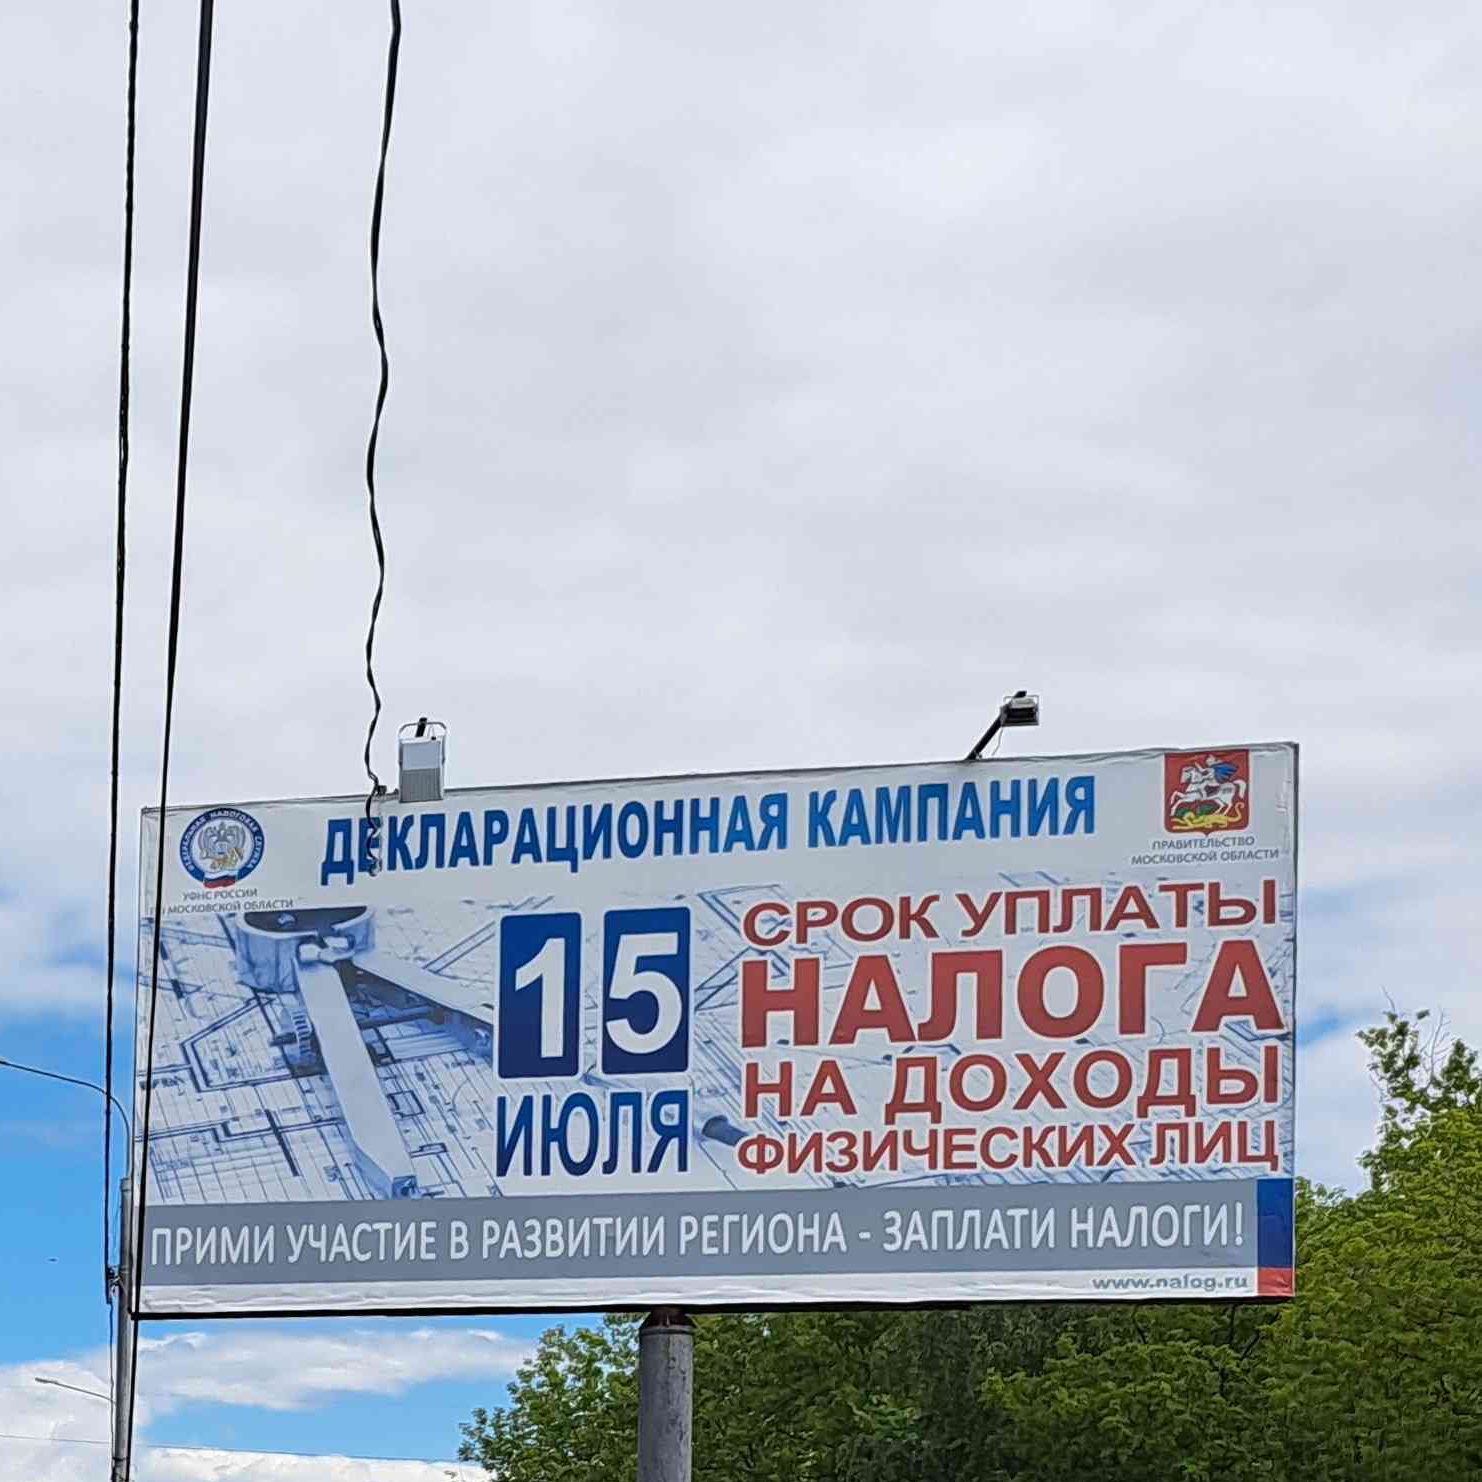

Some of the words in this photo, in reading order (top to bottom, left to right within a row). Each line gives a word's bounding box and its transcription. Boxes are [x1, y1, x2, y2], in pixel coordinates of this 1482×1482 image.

[321, 792, 789, 885] ДЕКЛАРАЦИОННАЯ
[808, 776, 1095, 848] КАМПАНИЯ
[1131, 850, 1217, 865] МОСКОВСКОЙ
[1221, 849, 1279, 860] ОБЛАСТИ
[1152, 836, 1255, 850] ПРАВИТЕЛЬСТВО
[168, 901, 241, 914] МОСКОВСКОЙ
[244, 900, 293, 910] ОБЛАСТИ
[182, 890, 212, 901] УФНС
[214, 888, 258, 899] РОССИИ
[744, 894, 939, 947] СРОК
[955, 880, 1276, 938] УПЛАТЫ
[515, 931, 683, 1058] 15
[741, 939, 1285, 1047] НАЛОГА
[744, 1060, 857, 1119] НА
[884, 1046, 1278, 1126] ДОХОДЫ
[496, 1089, 690, 1178] ИЮЛЯ
[738, 1123, 1136, 1175] ФИЗИЧЕСКИХ
[1150, 1120, 1279, 1172] ЛИЦ
[151, 1226, 275, 1265] ПРИМИ
[286, 1220, 437, 1264] УЧАСТИЕ
[449, 1221, 469, 1260] В
[481, 1215, 666, 1260] РАЗВИТИИ
[679, 1211, 847, 1255] РЕГИОНА
[882, 1207, 1054, 1251] ЗАПЛАТИ
[1070, 1201, 1245, 1248] НАЛОГИ!
[1091, 1274, 1248, 1292] www.nalog.ru
